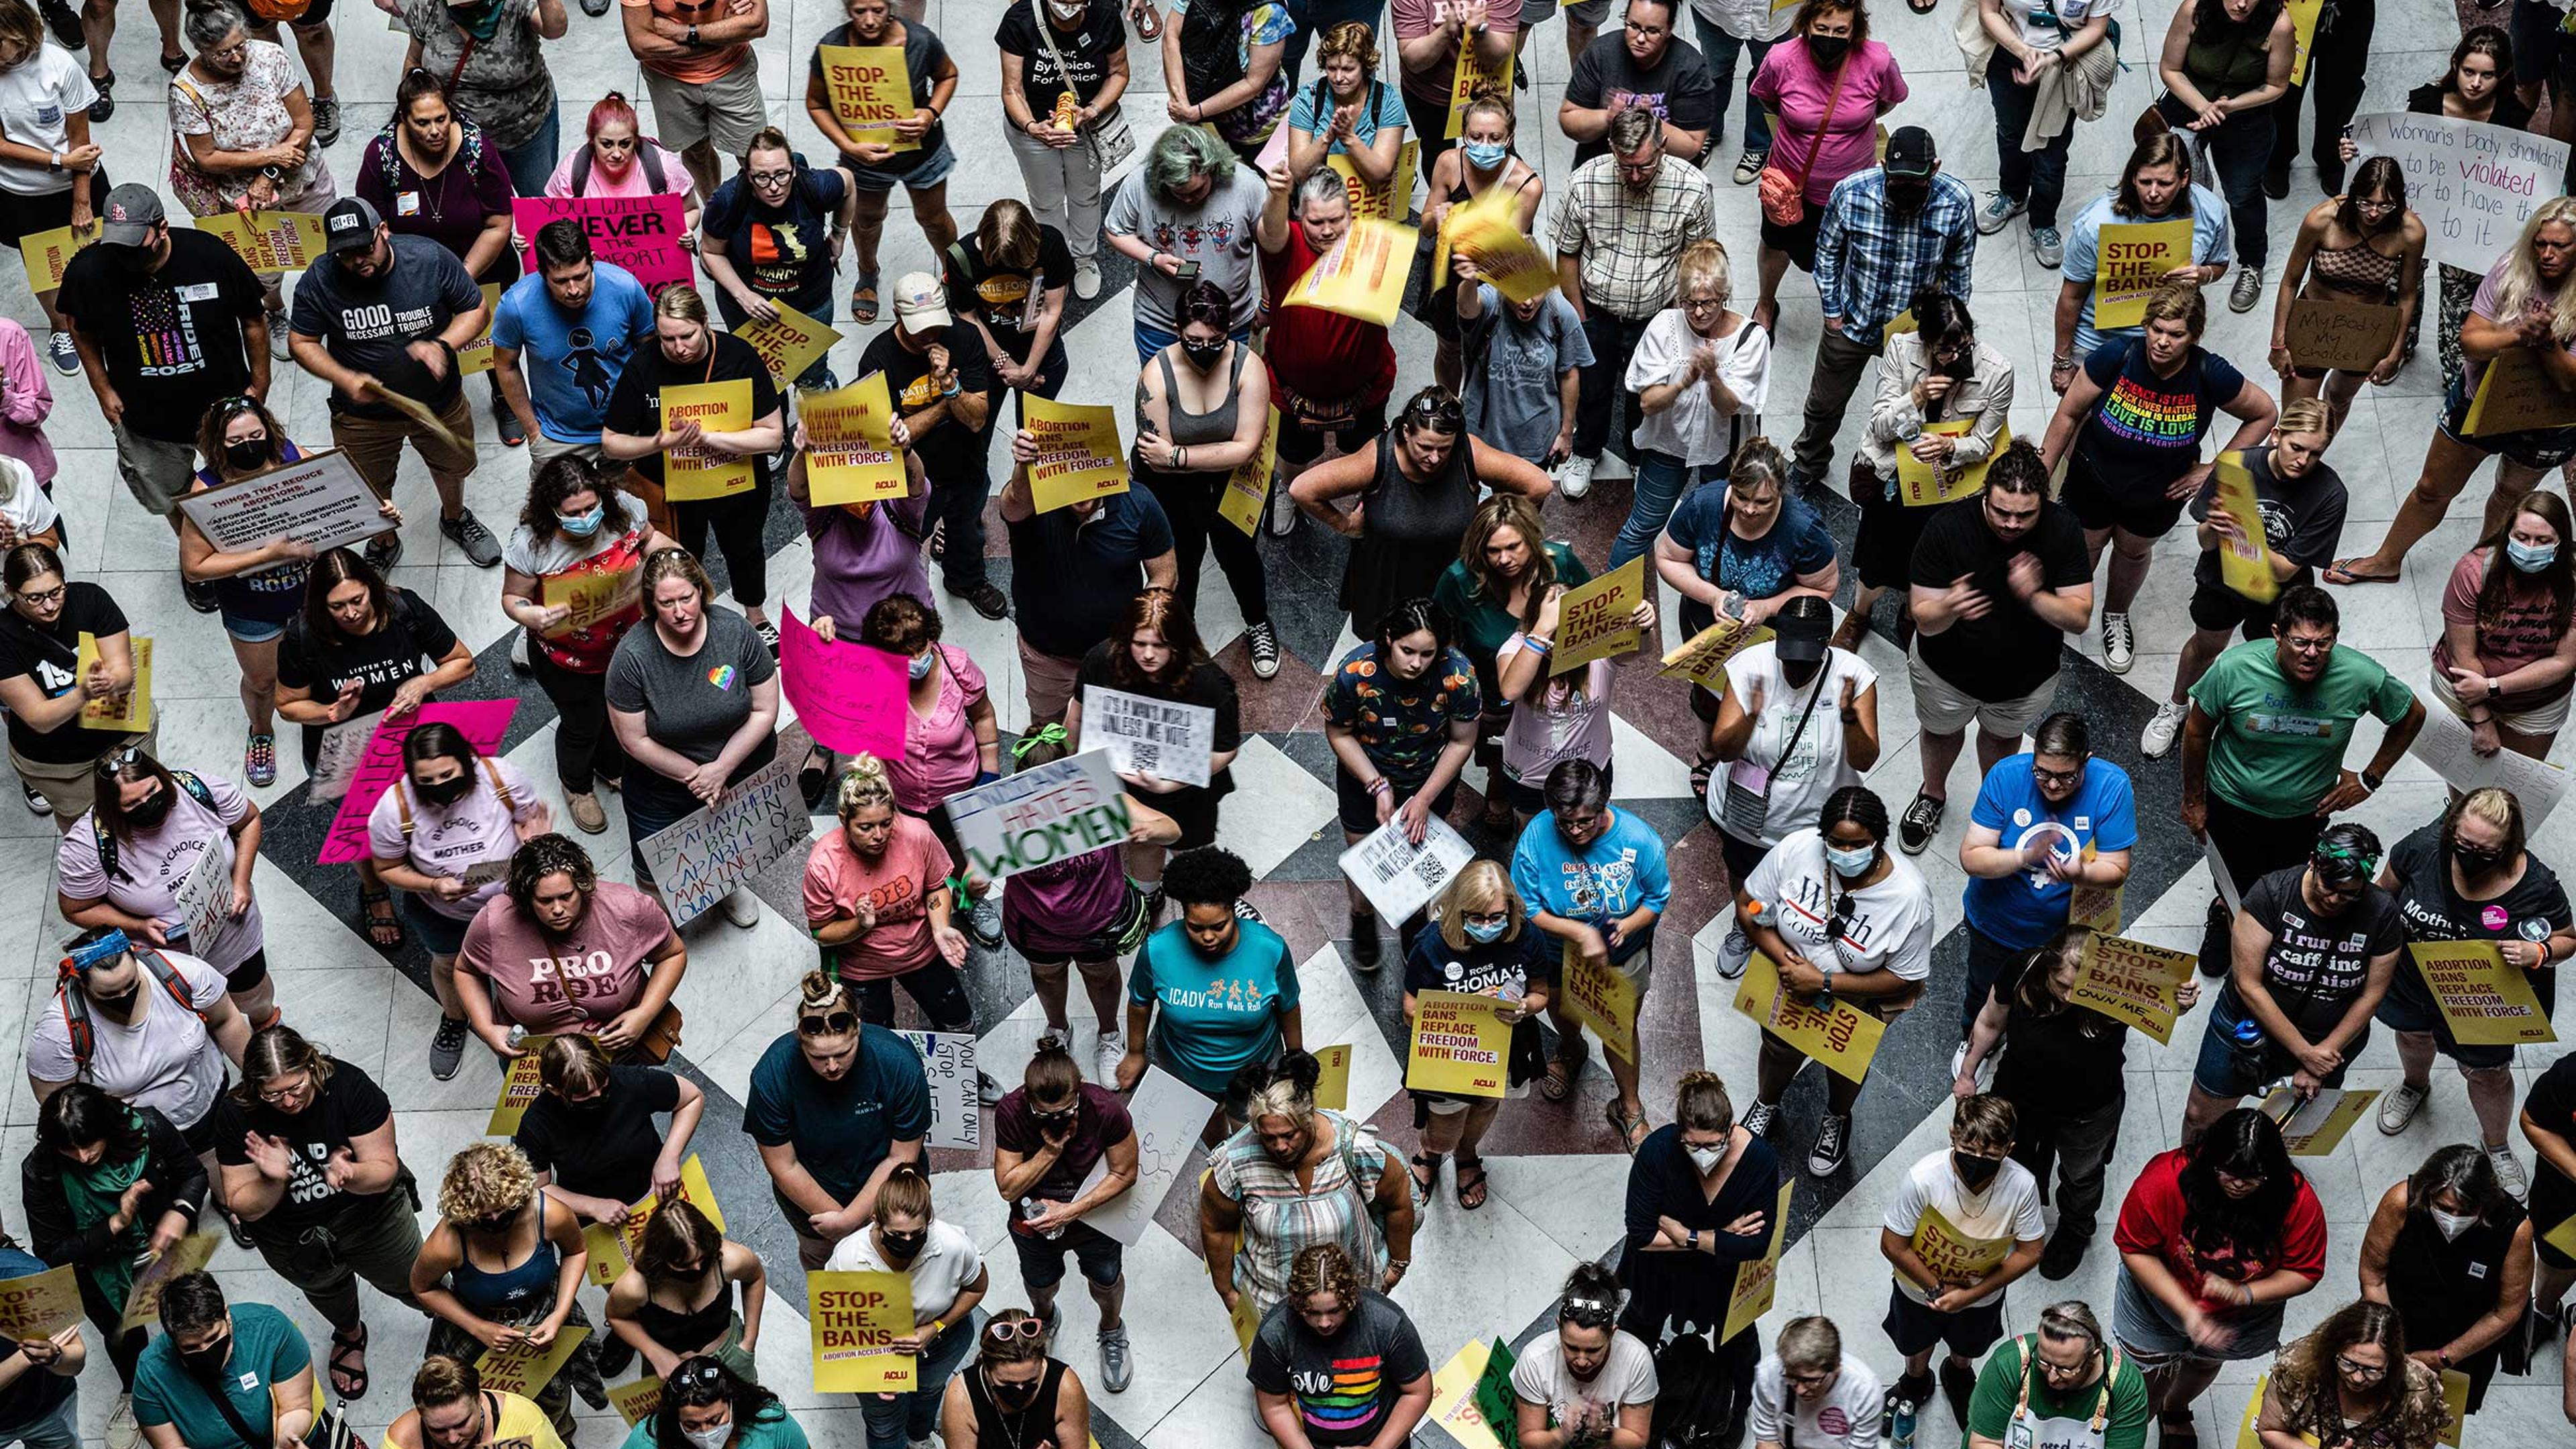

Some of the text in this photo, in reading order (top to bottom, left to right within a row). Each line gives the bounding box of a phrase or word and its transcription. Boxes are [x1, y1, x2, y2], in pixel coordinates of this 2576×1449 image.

[832, 66, 889, 83] STOP.
[1034, 61, 1052, 72] By
[1033, 74, 1054, 83] For
[837, 85, 881, 102] THE.
[841, 104, 902, 120] BANS.
[2357, 119, 2373, 140] A
[2464, 127, 2500, 160] body
[2407, 154, 2535, 196] to be violated
[539, 198, 669, 216] YOU WILL
[2435, 182, 2502, 215] to have
[2441, 207, 2491, 246] to it
[256, 231, 276, 268] REPLACE
[269, 229, 292, 266] FREEDOM
[603, 238, 637, 248] THE
[2107, 241, 2170, 258] STOP.
[47, 245, 62, 283] ABORTION
[290, 246, 307, 266] WITH
[2106, 260, 2157, 277] THE.
[342, 304, 431, 330] GOOD TROUBLE
[346, 324, 394, 341] NECESSARY
[398, 315, 434, 333] TROUBLE
[2300, 311, 2382, 338] My Body
[745, 326, 784, 356] THE.
[758, 317, 810, 348] STOP.
[2314, 332, 2341, 346] My
[899, 384, 928, 398] KATIE
[2114, 386, 2196, 414] BLACK LIVES MATTER
[668, 402, 729, 418] ABORTION
[2105, 398, 2195, 435] LOVE IS LOVE
[2110, 392, 2196, 422] NO HUMAN IS ILLEGAL
[1029, 417, 1089, 431] ABORTION
[812, 441, 870, 454] FREEDOM
[1034, 449, 1091, 466] FREEDOM
[671, 458, 702, 471] WITH
[814, 450, 892, 469] WITH FORCE.
[1035, 457, 1113, 480] WITH FORCE.
[211, 469, 325, 508] THINGS THAT REDUCE
[727, 475, 747, 486] ACLU
[875, 480, 898, 490] ACLU
[1095, 478, 1118, 488] ACLU
[214, 485, 327, 524] AFFORDABLE HEALTHCARE
[216, 511, 268, 531] EDUCATION
[221, 512, 291, 537] LIVABLE WAGES
[226, 494, 362, 541] INVESTMENTS IN COMMUNITIES
[230, 502, 359, 547] QUALITY CHILDCARE OPTIONS
[306, 519, 352, 539] YOU THINK
[1567, 586, 1623, 621] STOP.
[1566, 609, 1613, 634] THE.
[1563, 617, 1630, 650] BANS.
[1610, 639, 1632, 650] ACLU
[331, 659, 415, 691] WOMEN
[349, 659, 394, 675] LISTEN TO
[998, 779, 1101, 833] HATES
[327, 808, 371, 861] SAFE
[649, 818, 700, 847] THIS
[676, 795, 782, 873] A BRAIN
[966, 793, 1132, 877] WOMEN
[161, 840, 207, 875] BY CHOICE
[435, 842, 485, 858] MOTHER
[653, 847, 678, 865] IS
[675, 848, 759, 909] MAKING
[194, 879, 228, 941] SAFE
[678, 889, 714, 922] OWN
[2096, 933, 2137, 953] YOU
[2284, 929, 2292, 943] I
[529, 949, 613, 982] PRO
[1468, 963, 1495, 976] ROSS
[2094, 959, 2147, 981] THE.
[2096, 947, 2166, 973] STOP.
[2425, 958, 2492, 971] ABORTION
[1571, 967, 1608, 1006] THE.
[2088, 969, 2165, 1004] BANS.
[2431, 971, 2468, 982] BANS
[529, 973, 619, 1005] ROE
[1169, 987, 1261, 1012] ICADV Run Walk Roll
[2086, 982, 2173, 1014] ABORTION ACCESS FOR ALL
[2436, 983, 2496, 994] REPLACE
[1424, 1000, 1488, 1012] ABORTION
[1570, 980, 1621, 1032] BANS.
[2076, 989, 2151, 1016] OWN ME
[2443, 996, 2504, 1006] FREEDOM
[2449, 1006, 2532, 1017] WITH FORCE.
[1422, 1010, 1457, 1020] BANS
[2142, 1016, 2163, 1034] ACLU
[1421, 1022, 1477, 1035] REPLACE
[1824, 1008, 1858, 1055] STOP.
[1419, 1033, 1479, 1049] FREEDOM
[936, 1042, 955, 1079] STOP
[1332, 1051, 1341, 1067] ACLU
[1418, 1045, 1497, 1065] WITH FORCE.
[953, 1037, 977, 1146] YOU CAN ONLY
[1472, 1078, 1497, 1088] ACLU
[1921, 1225, 1986, 1260] STOP.
[1920, 1240, 1970, 1269] THE.
[818, 1290, 889, 1307] STOP.
[820, 1311, 877, 1328] THE.
[822, 1347, 881, 1360] ABORTION ACCESS
[486, 1356, 526, 1379] THE.
[884, 1371, 908, 1382] ACLU
